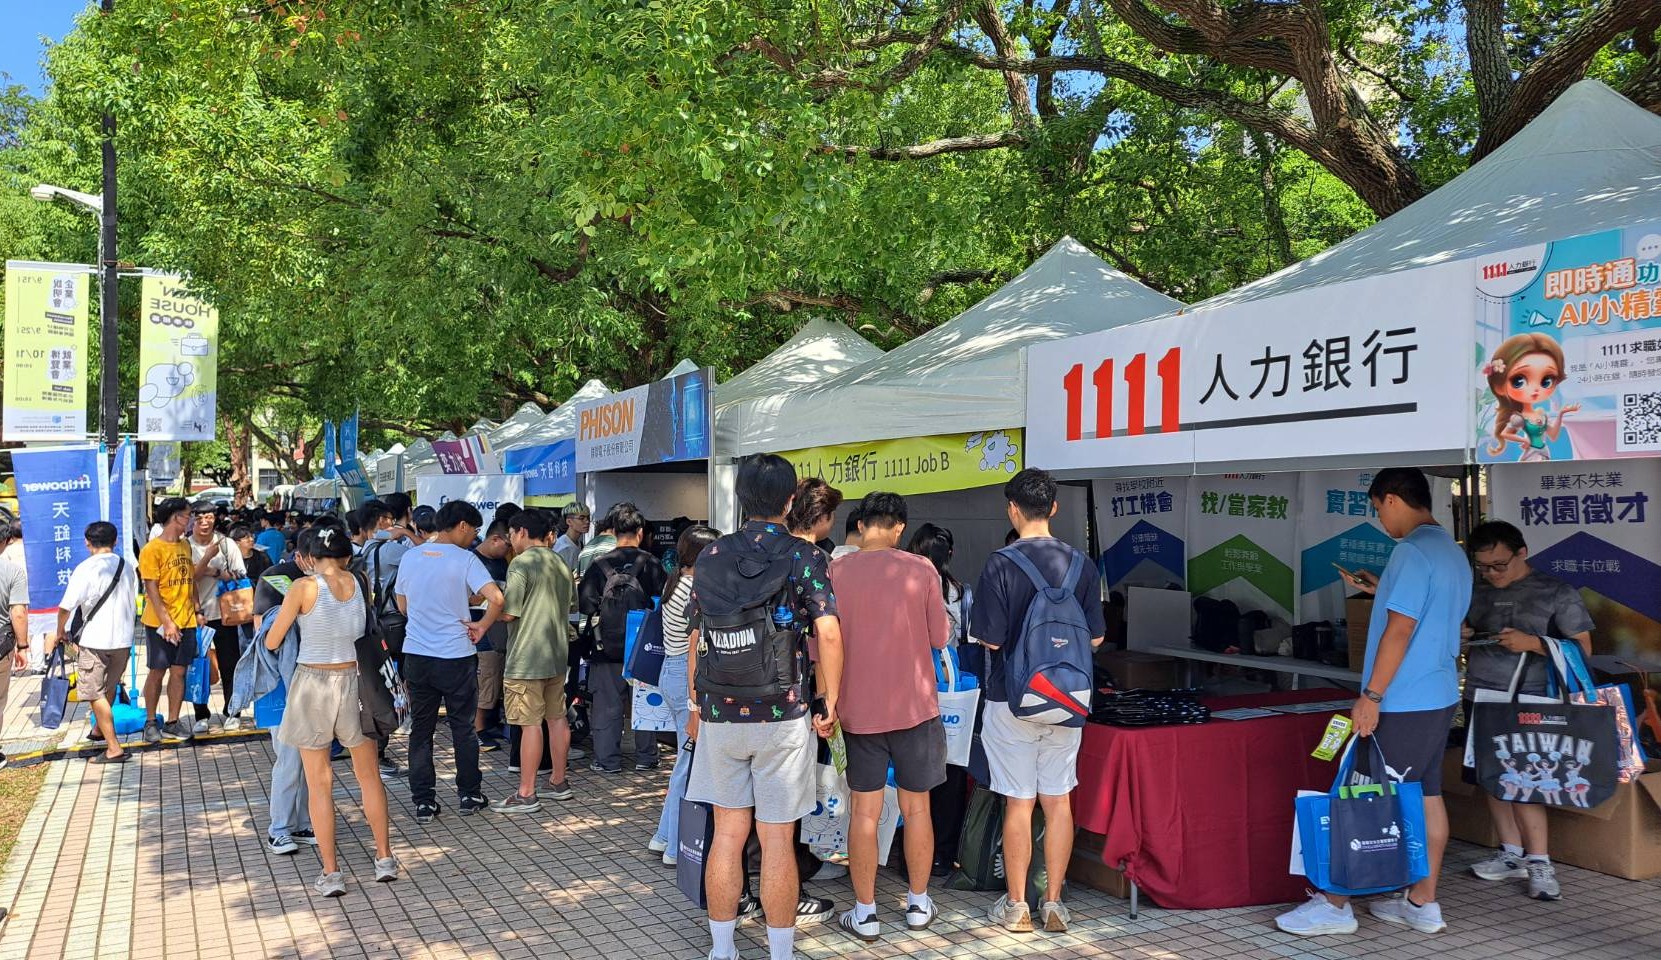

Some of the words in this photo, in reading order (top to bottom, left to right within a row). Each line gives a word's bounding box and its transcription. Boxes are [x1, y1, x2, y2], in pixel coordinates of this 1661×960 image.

[1557, 287, 1661, 328] AI小精
[1601, 343, 1627, 356] 1111
[1063, 346, 1181, 441] 1111
[1199, 326, 1419, 405] 人力銀行
[579, 397, 635, 442] PHISON
[793, 450, 878, 484] 11人力銀行
[1540, 471, 1623, 490] 畢業不失業
[1111, 490, 1173, 518] 打工機會
[1200, 490, 1289, 521] 找/當家教
[1519, 491, 1649, 526] 校園徵才
[1551, 559, 1621, 573] 求職卡位戰
[1491, 731, 1595, 760] TAIWAN
